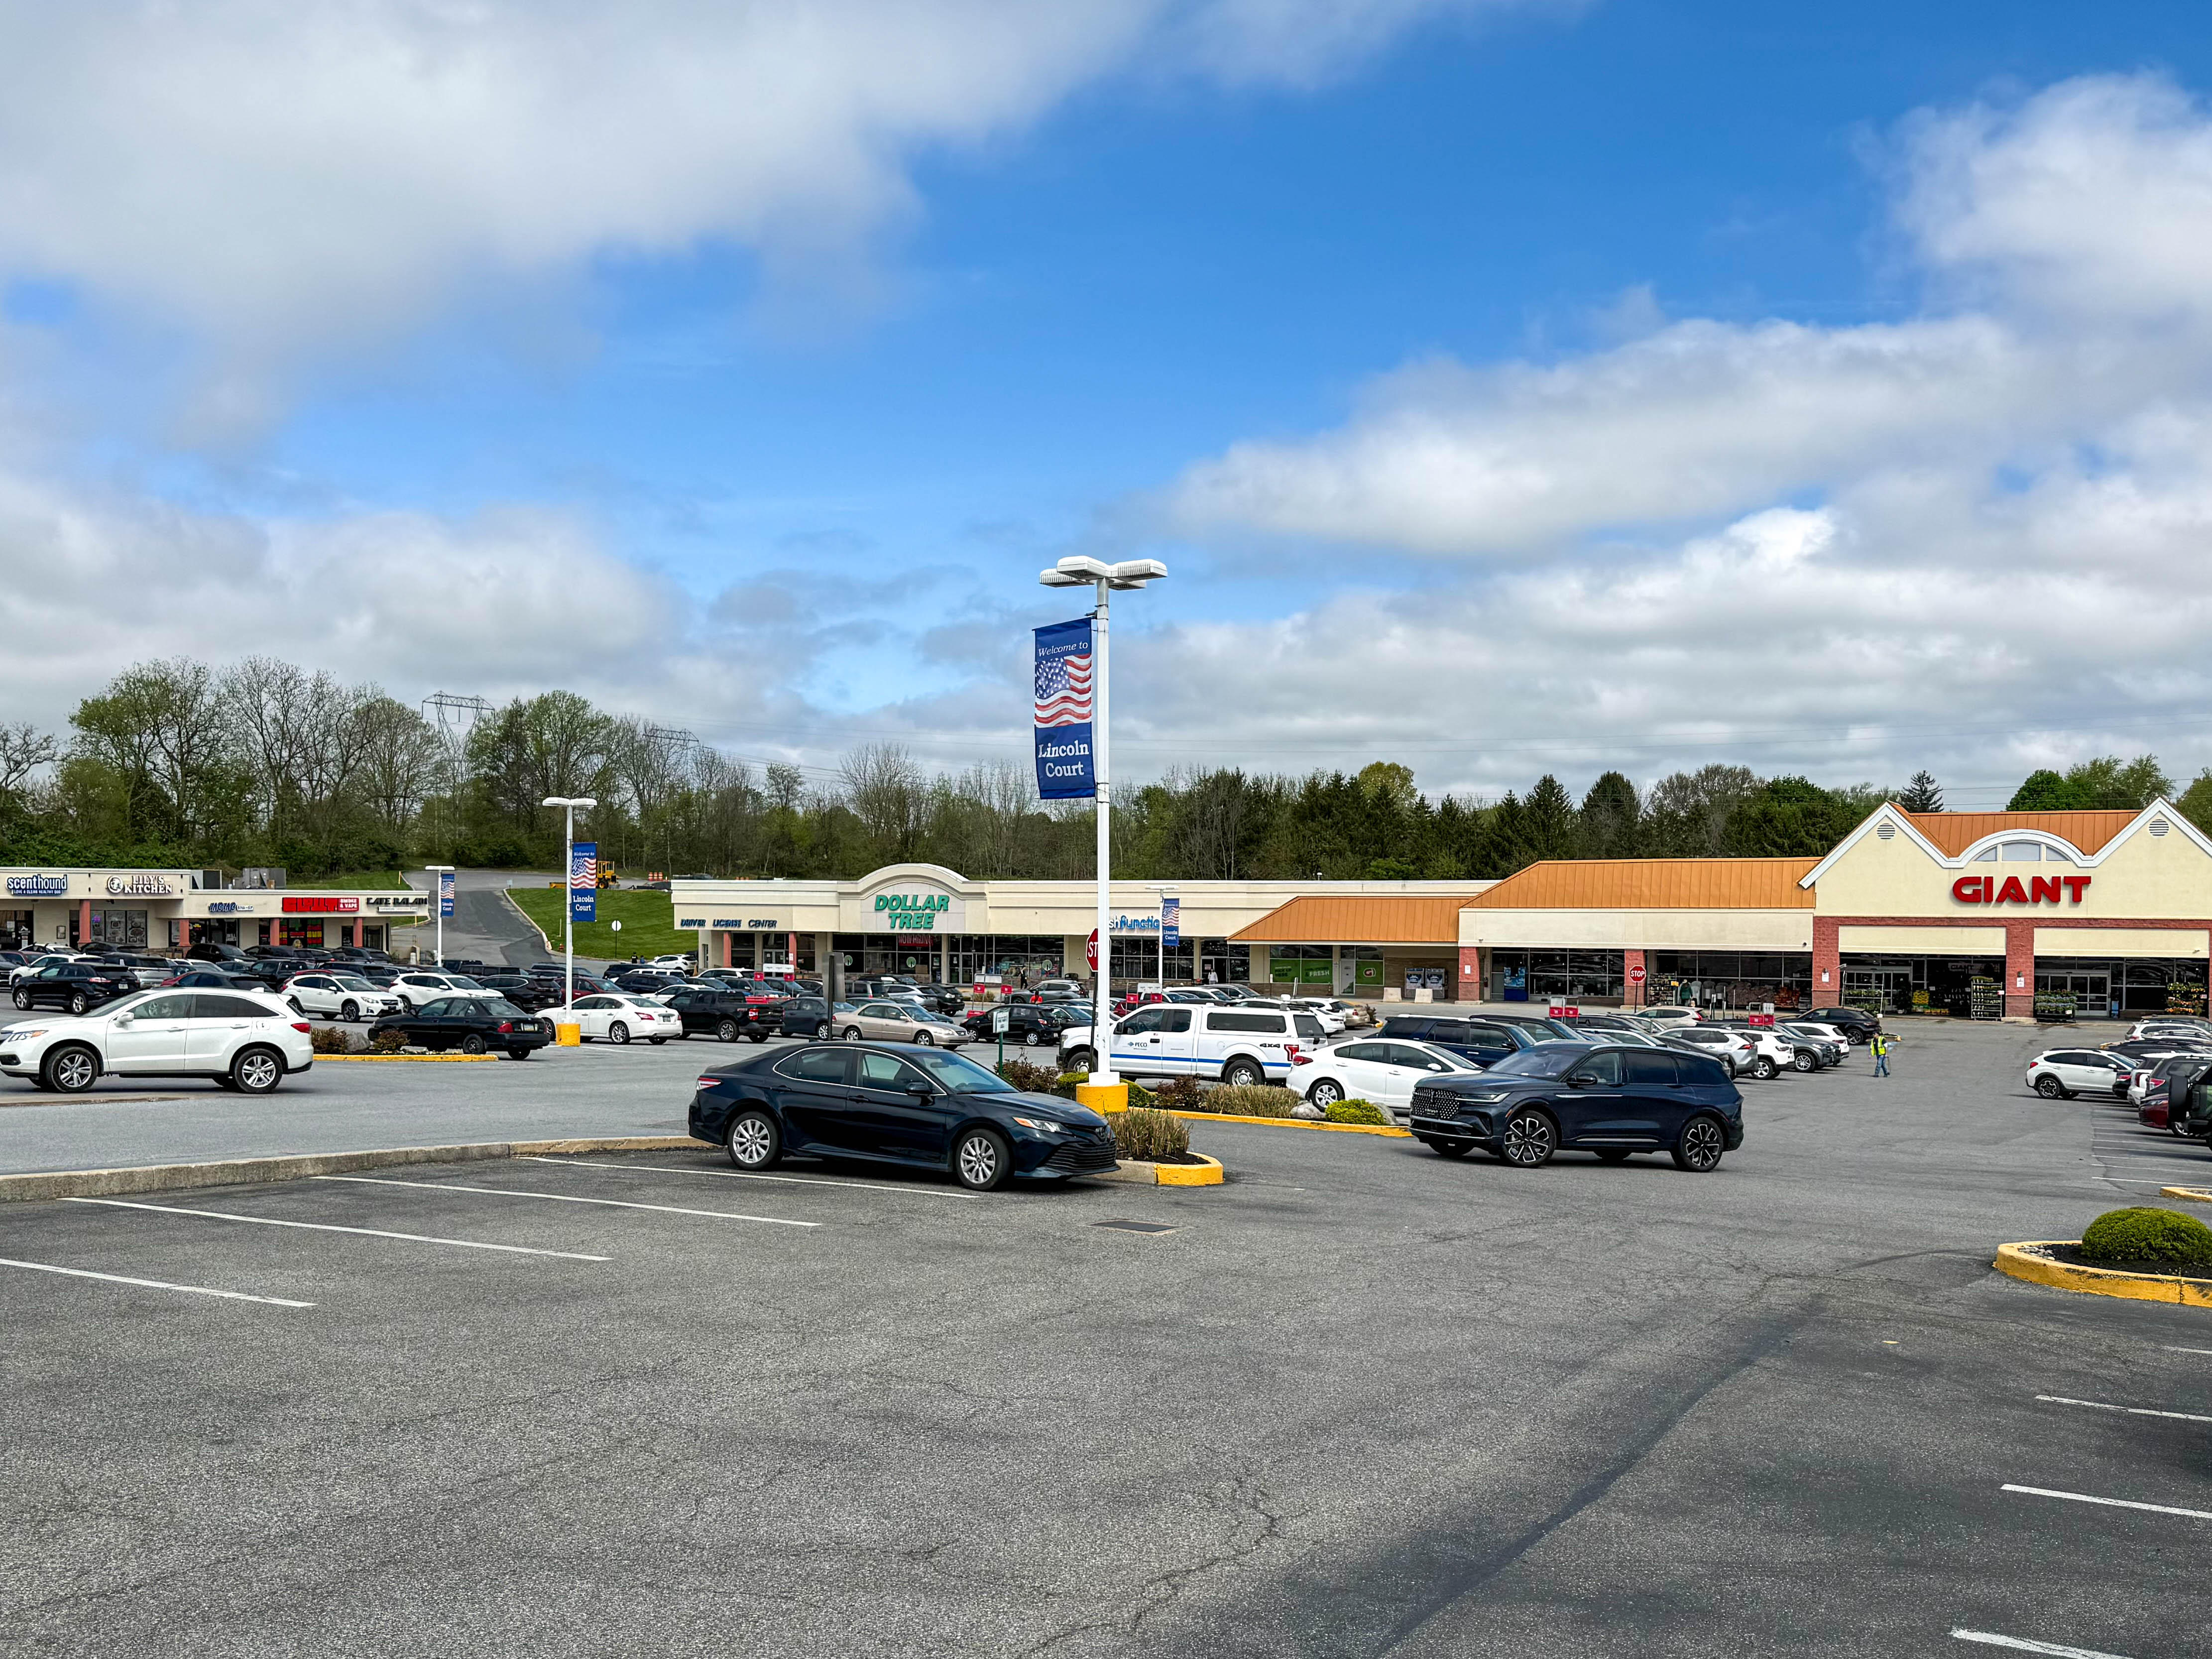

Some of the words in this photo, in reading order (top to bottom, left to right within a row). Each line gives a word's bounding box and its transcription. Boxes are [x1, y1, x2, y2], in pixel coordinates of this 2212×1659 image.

[1039, 643, 1076, 657] Welcome
[1038, 740, 1089, 758] Lincoln
[1046, 761, 1084, 777] Court
[7, 874, 67, 889] scenthound
[132, 876, 164, 884] LILY'S
[123, 884, 173, 893] KITCHEN
[1952, 876, 2092, 903] GIANT
[875, 894, 950, 911] DOLLAR
[681, 919, 706, 927] DRIVER
[712, 919, 742, 928] LICENSE
[748, 919, 777, 928] CENTER
[888, 913, 936, 929] TREE
[1109, 915, 1160, 929] shfunctio
[1088, 941, 1098, 957] ST
